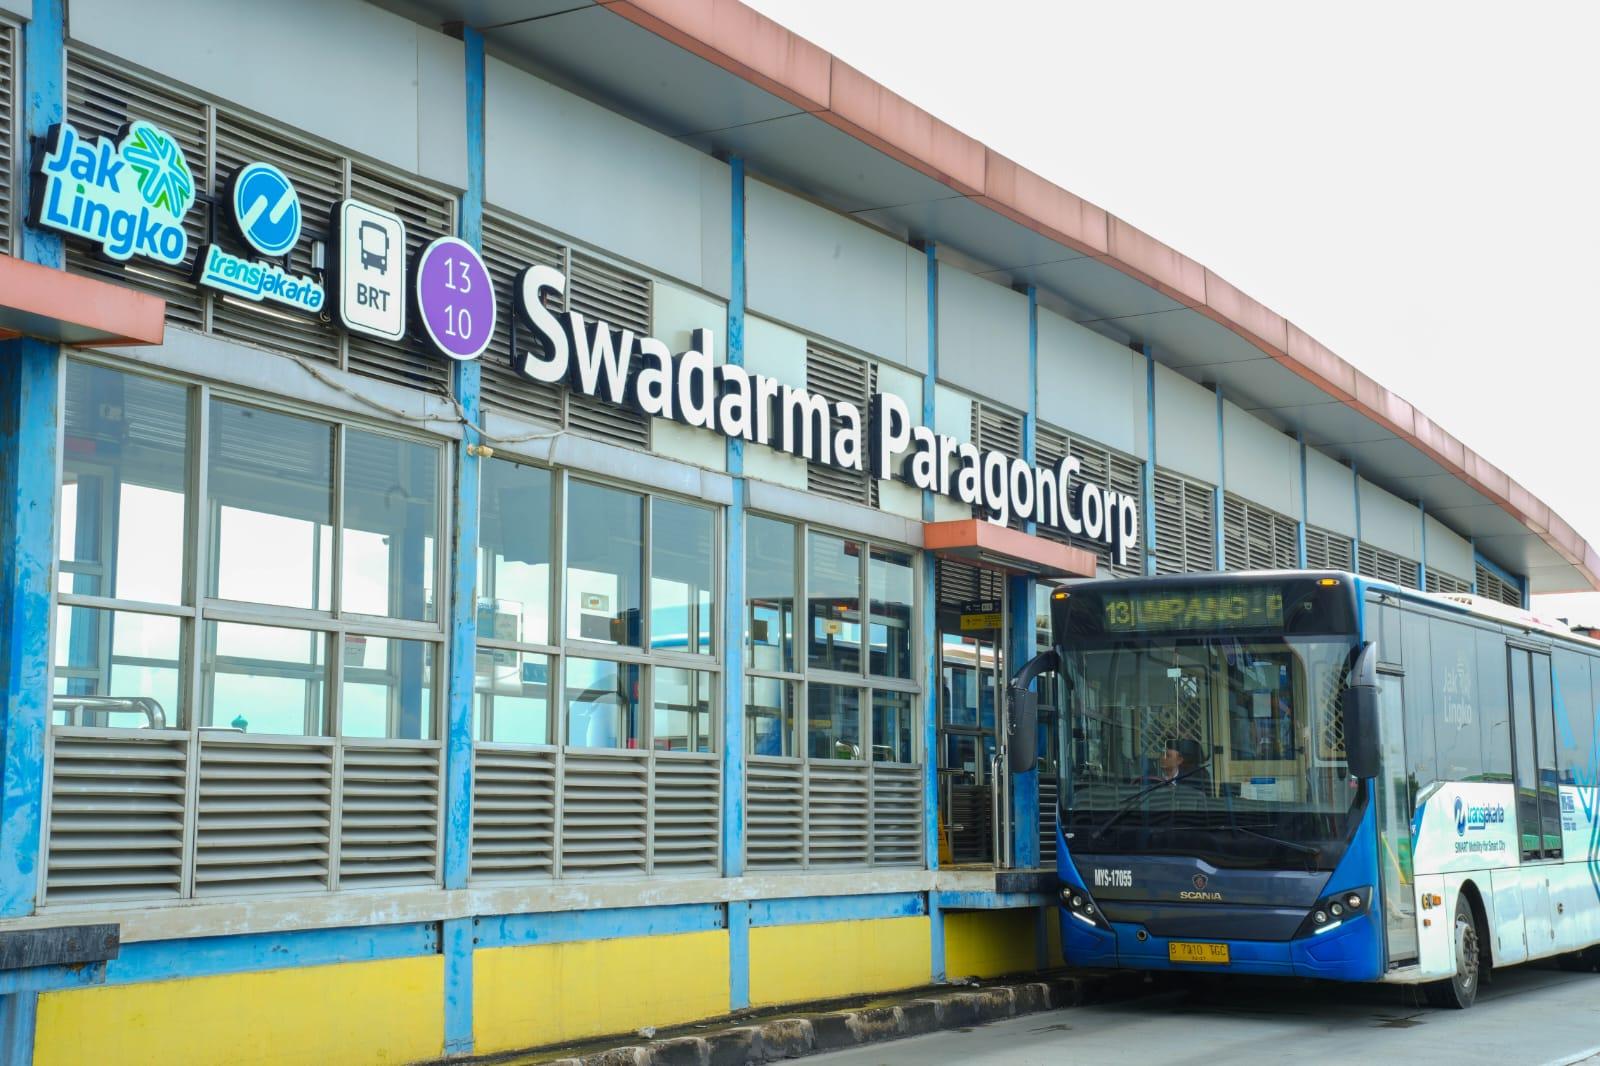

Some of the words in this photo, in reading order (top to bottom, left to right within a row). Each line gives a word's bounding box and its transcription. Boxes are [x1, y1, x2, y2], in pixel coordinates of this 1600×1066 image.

[48, 129, 124, 194] Jak
[47, 177, 185, 260] Lingko
[207, 247, 322, 308] transjakarta
[443, 256, 472, 294] 13
[356, 282, 391, 313] BRT
[443, 303, 473, 341] 10
[520, 264, 864, 472] Swadarma
[879, 392, 1138, 566] ParagonCorp
[1467, 803, 1505, 830] transjakarta
[1094, 869, 1133, 887] MYS-17055
[1180, 891, 1223, 900] SCANIA
